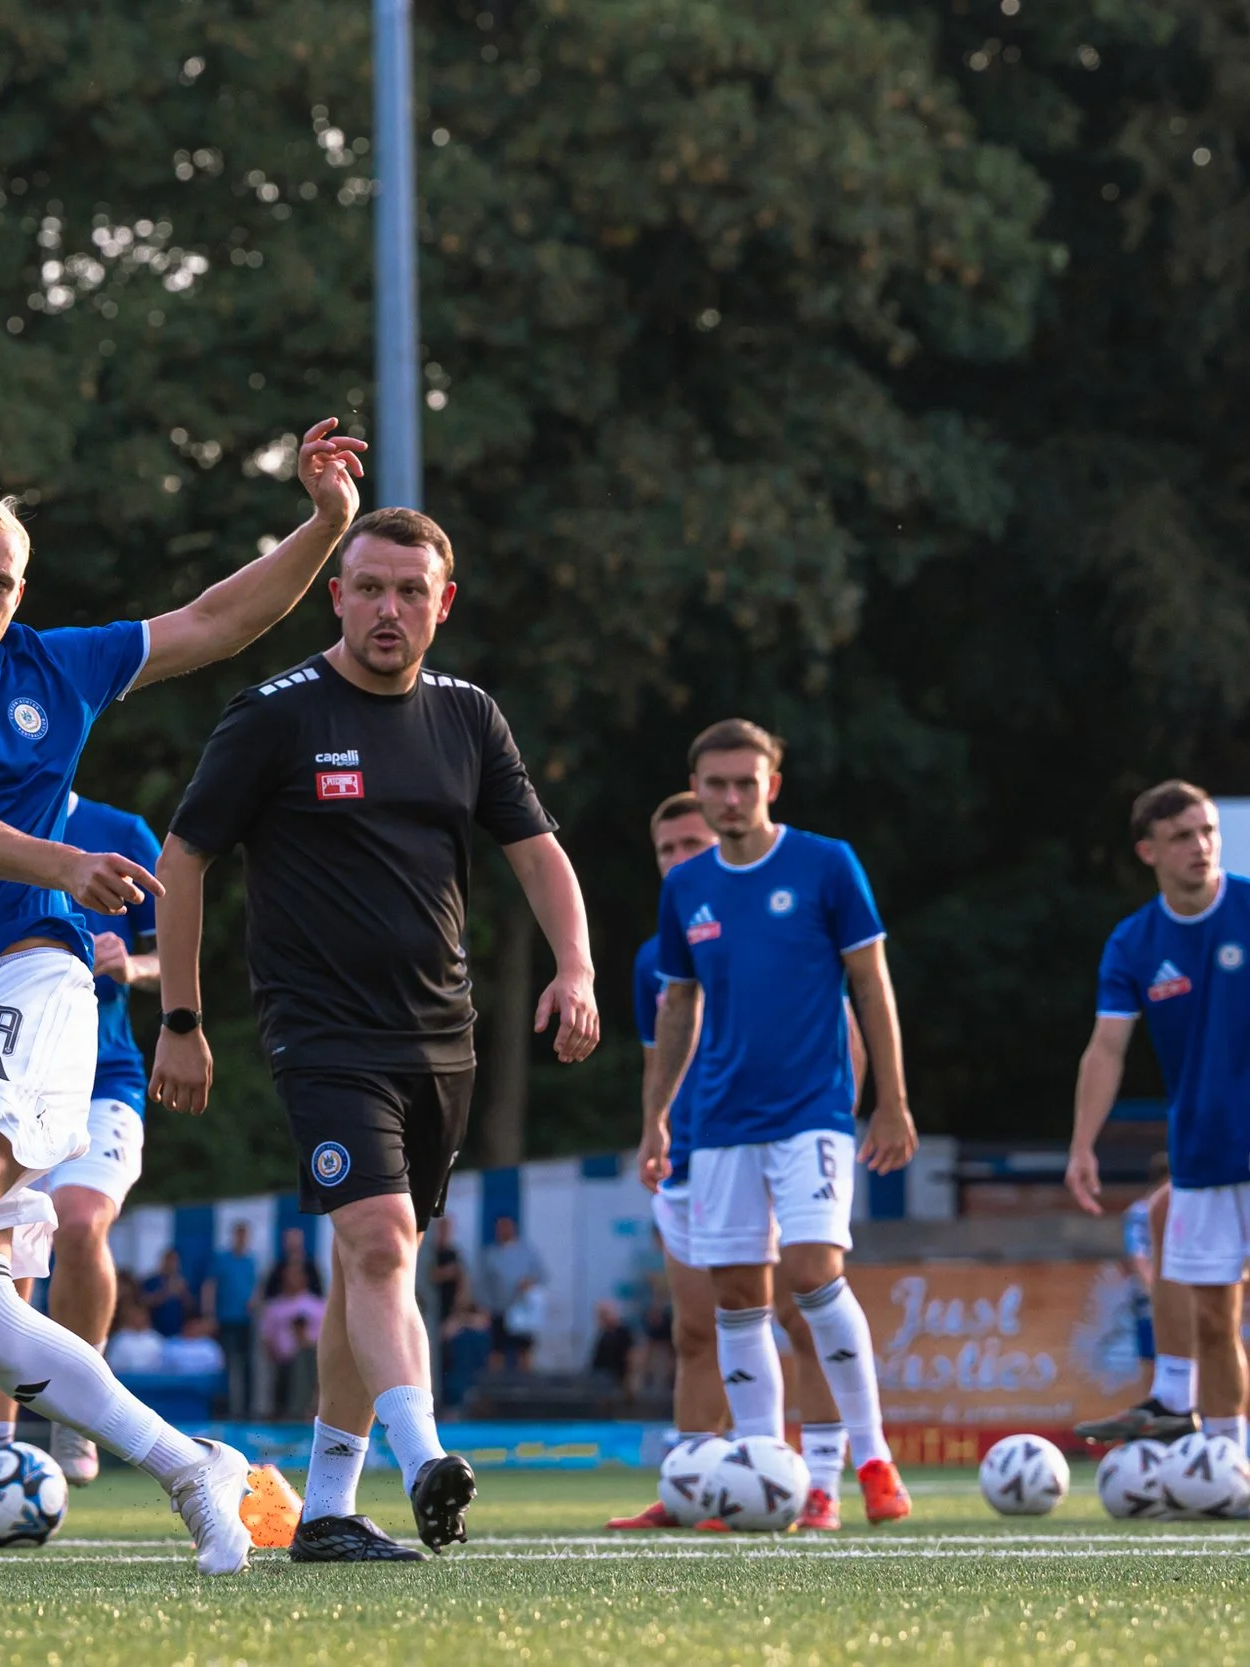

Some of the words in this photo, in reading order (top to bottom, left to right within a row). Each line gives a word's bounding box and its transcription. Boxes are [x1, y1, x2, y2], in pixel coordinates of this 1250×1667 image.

[315, 749, 359, 766] capelli
[815, 1136, 837, 1179] 6
[888, 1275, 1024, 1354] Just
